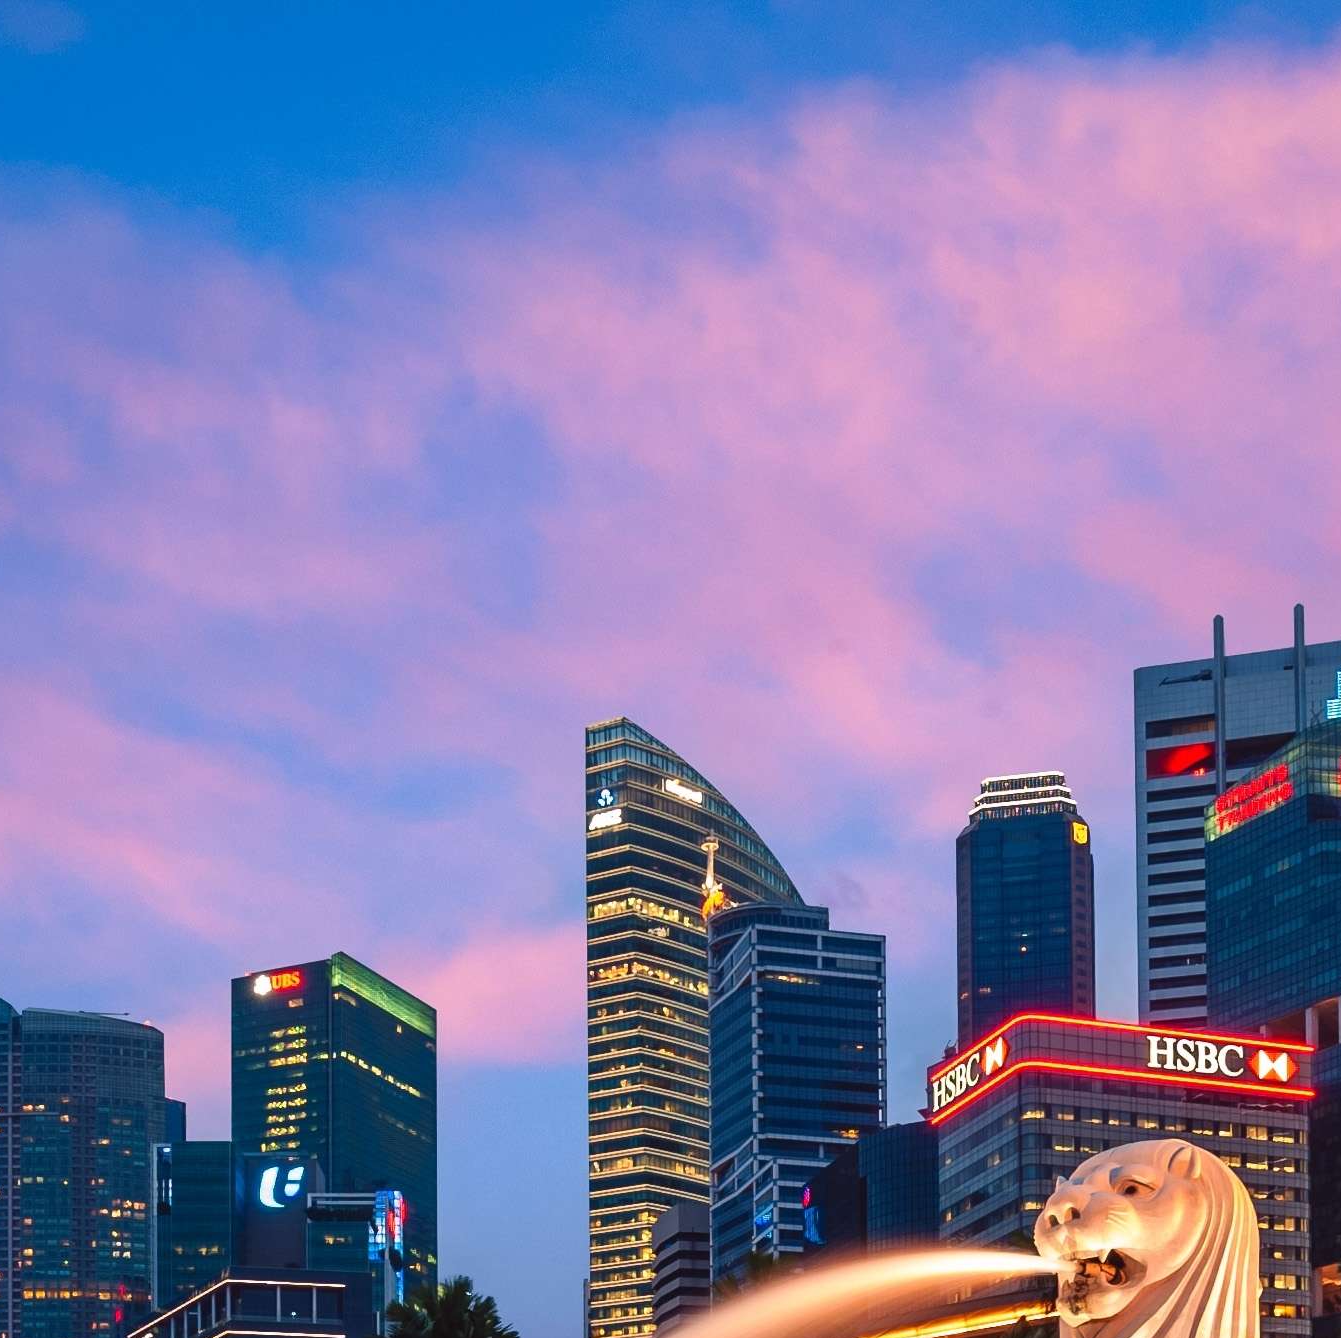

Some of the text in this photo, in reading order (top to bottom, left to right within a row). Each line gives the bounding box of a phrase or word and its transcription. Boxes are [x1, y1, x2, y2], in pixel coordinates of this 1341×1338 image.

[271, 970, 301, 989] UBS
[1147, 1036, 1244, 1077] HSBC
[932, 1052, 980, 1113] HSBC
